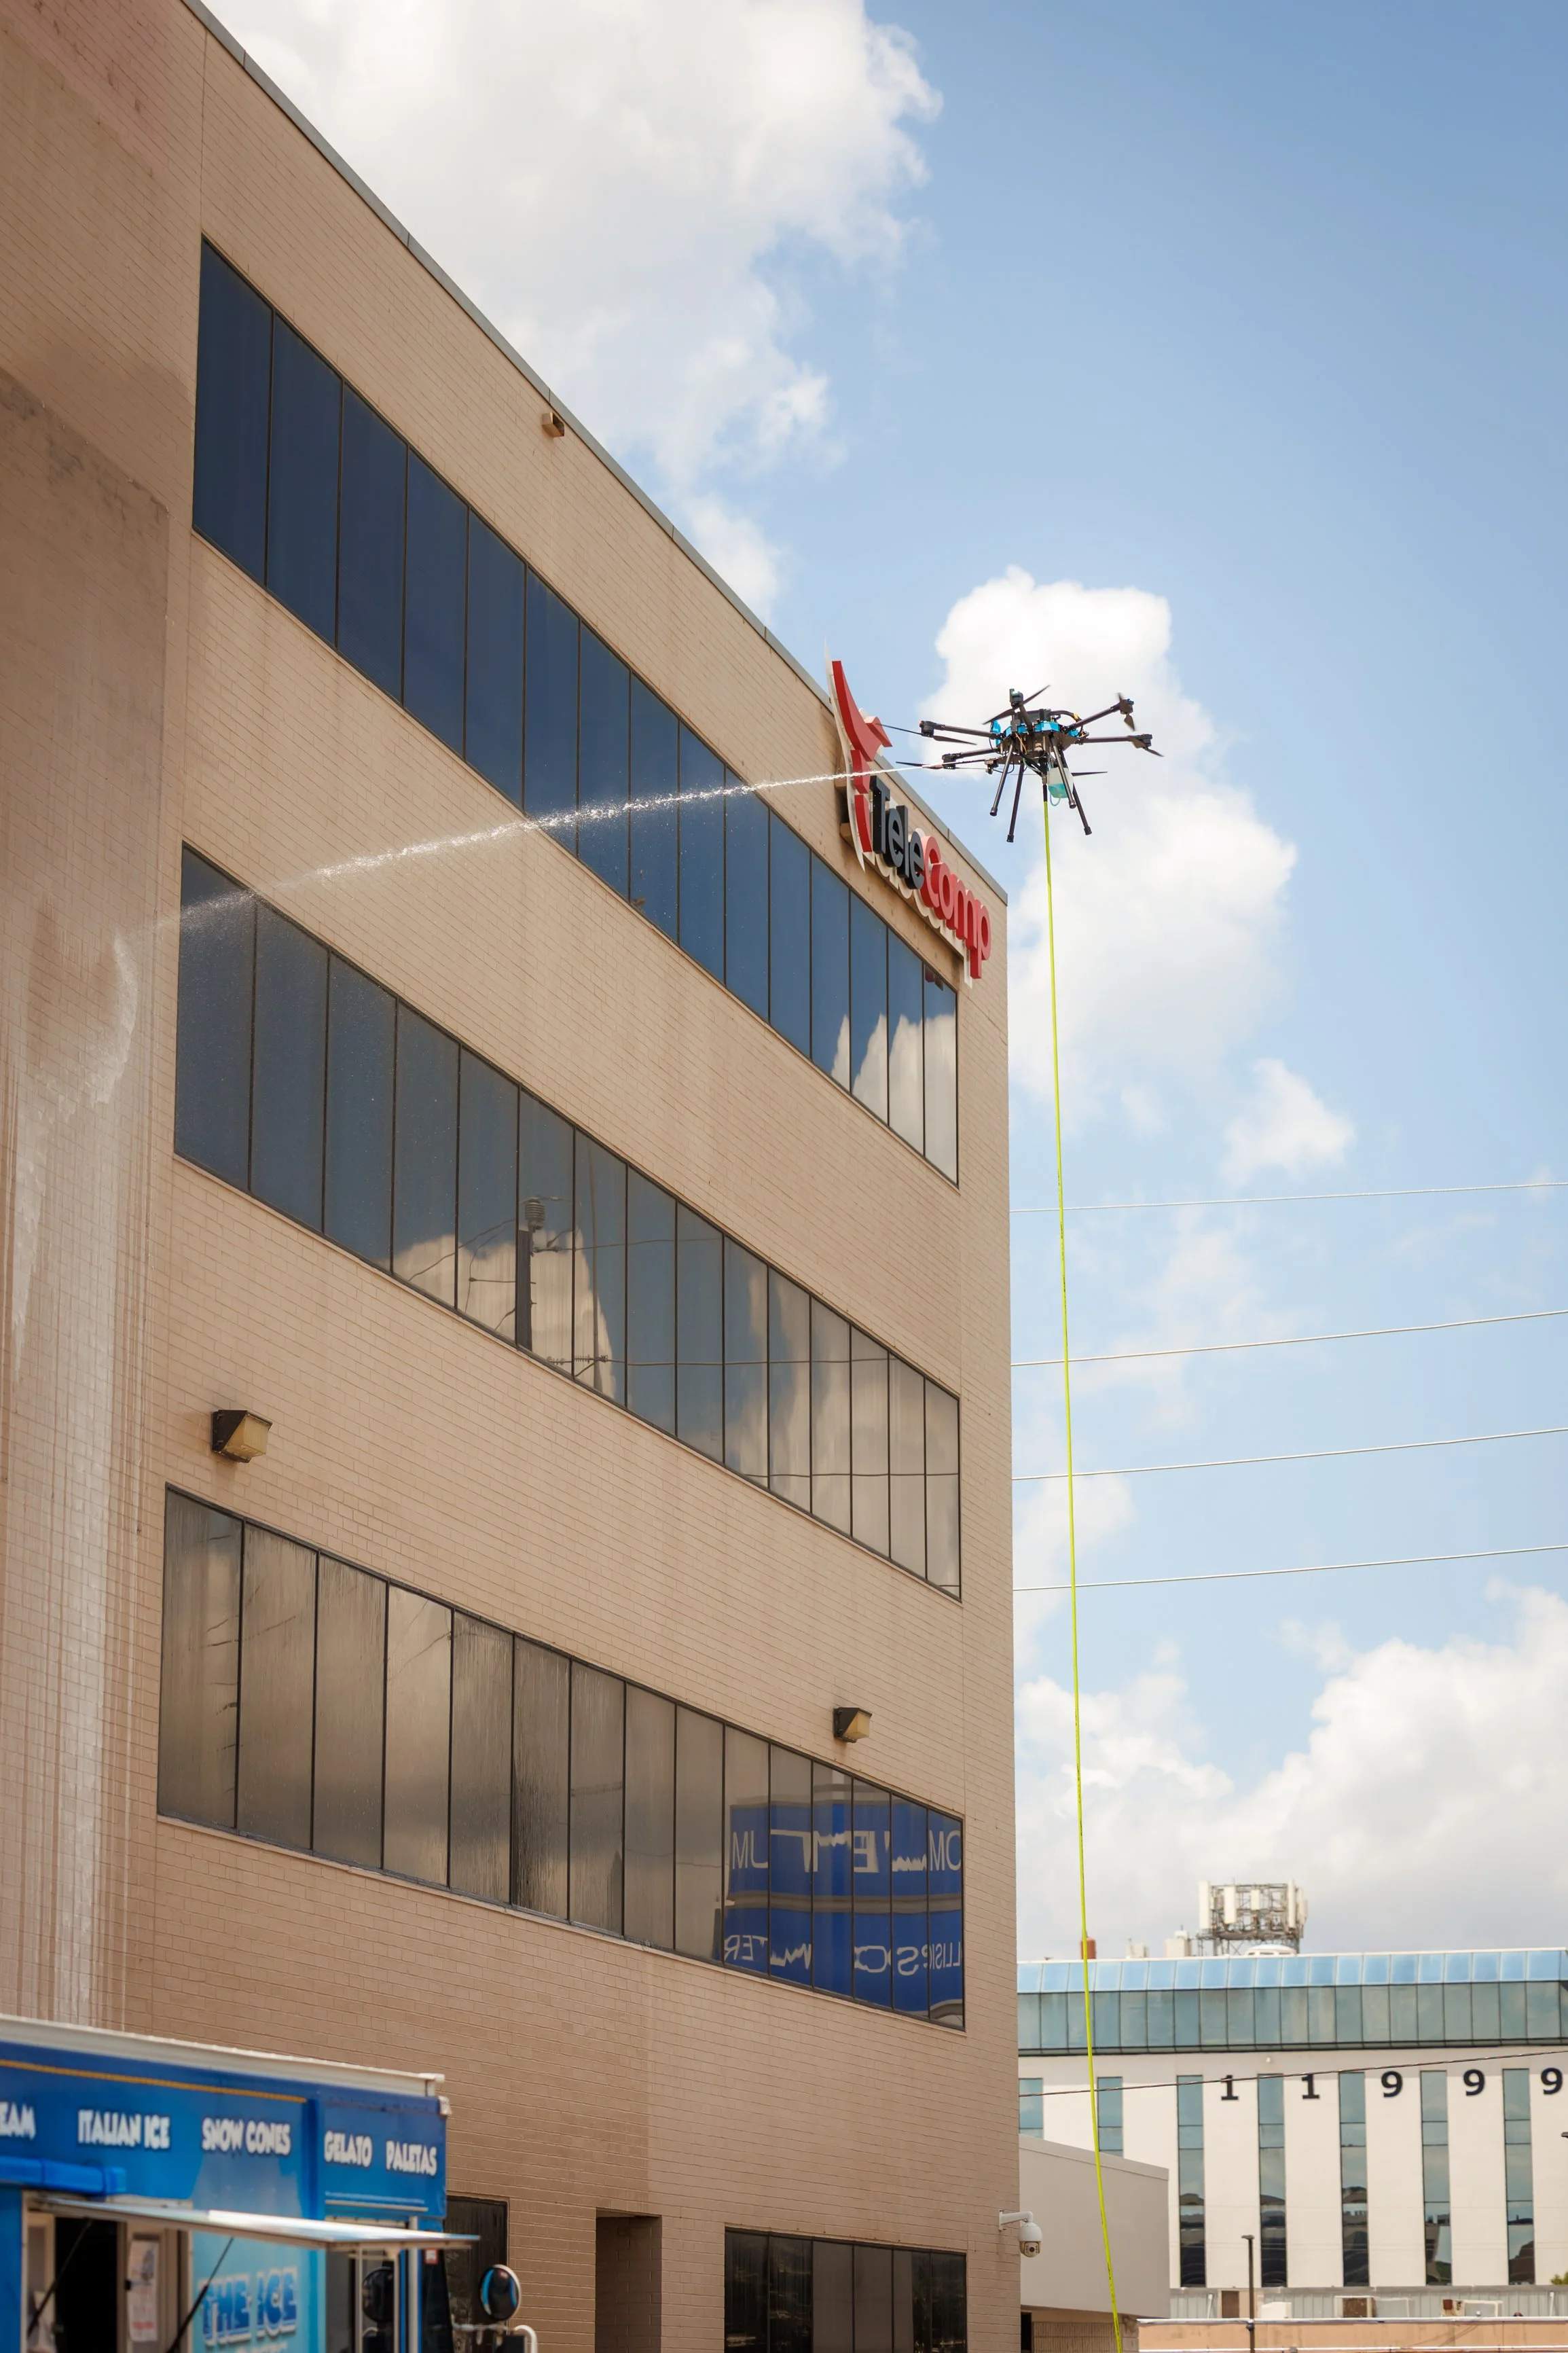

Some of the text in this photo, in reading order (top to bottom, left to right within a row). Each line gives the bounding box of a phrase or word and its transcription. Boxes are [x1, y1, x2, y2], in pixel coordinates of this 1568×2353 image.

[78, 2109, 170, 2149] ITALIAN ICE
[202, 2118, 291, 2155] SNOW CONES
[324, 2131, 373, 2167] GELATO
[386, 2140, 437, 2176] PALETAS
[198, 2267, 297, 2346] THE ICE
